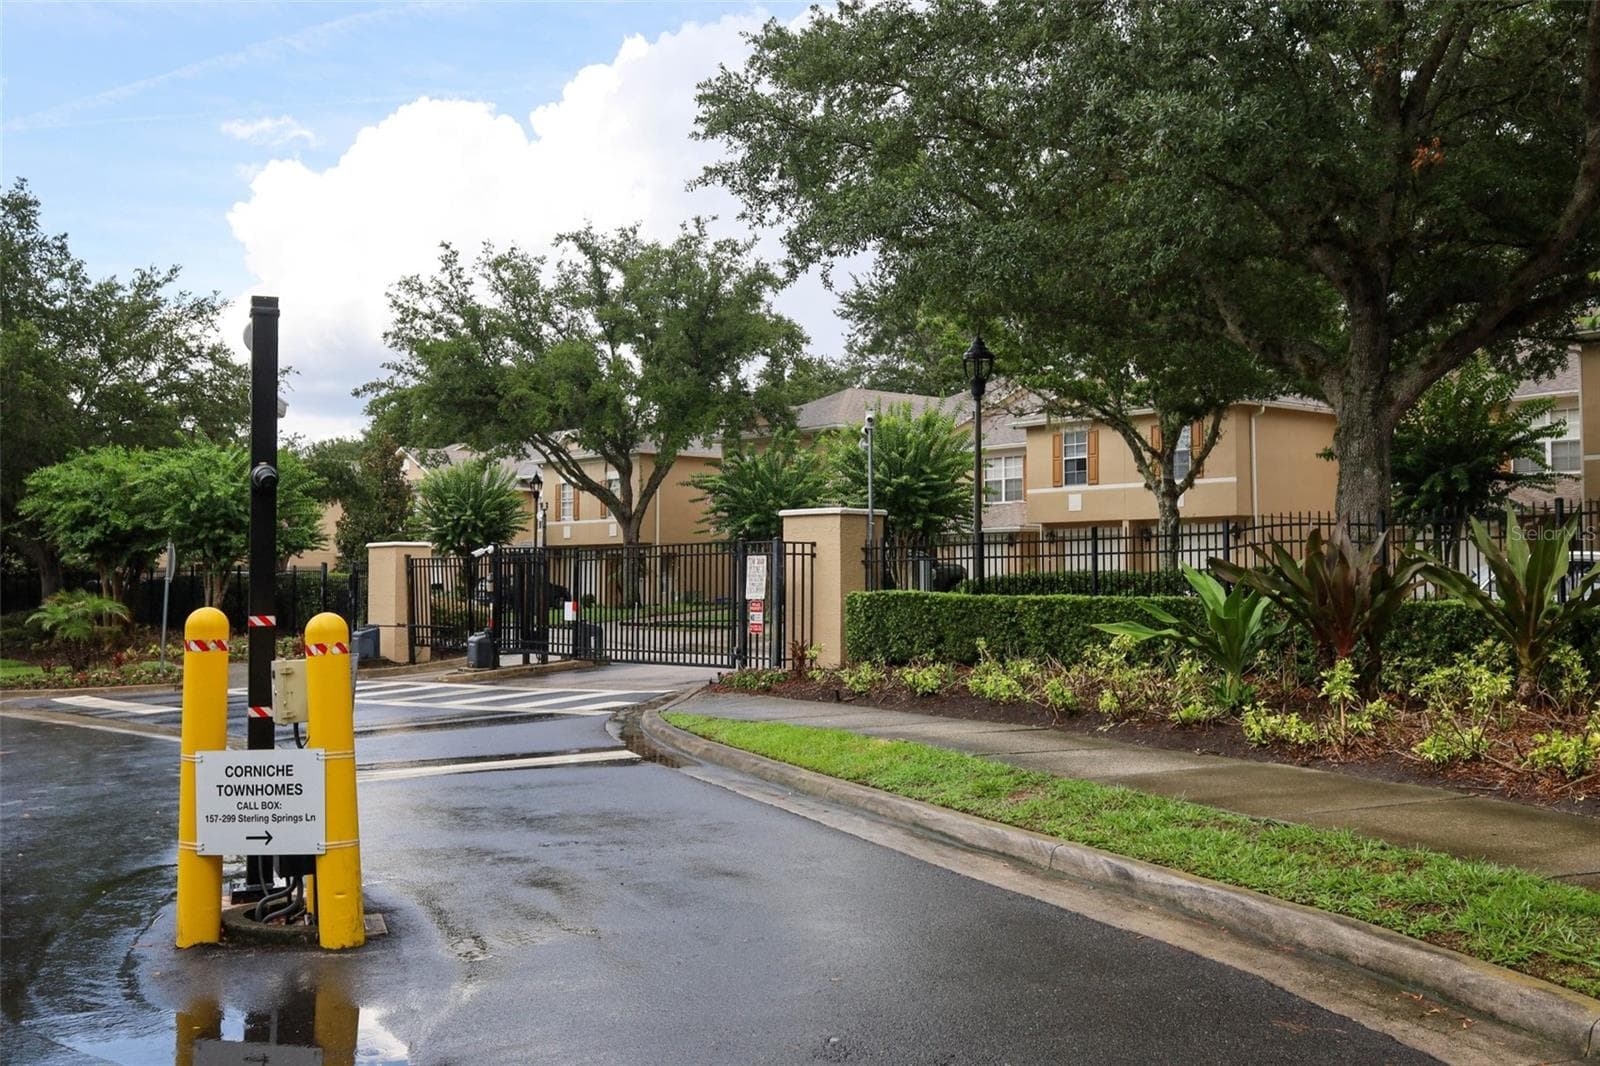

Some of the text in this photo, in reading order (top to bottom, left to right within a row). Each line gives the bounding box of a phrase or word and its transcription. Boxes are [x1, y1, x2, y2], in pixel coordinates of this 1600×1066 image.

[224, 764, 294, 778] CORNICHE
[216, 783, 304, 797] TOWNHOMES
[236, 801, 282, 810] CALL BOX:
[205, 813, 316, 824] 157-299 Sterling Springs Ln
